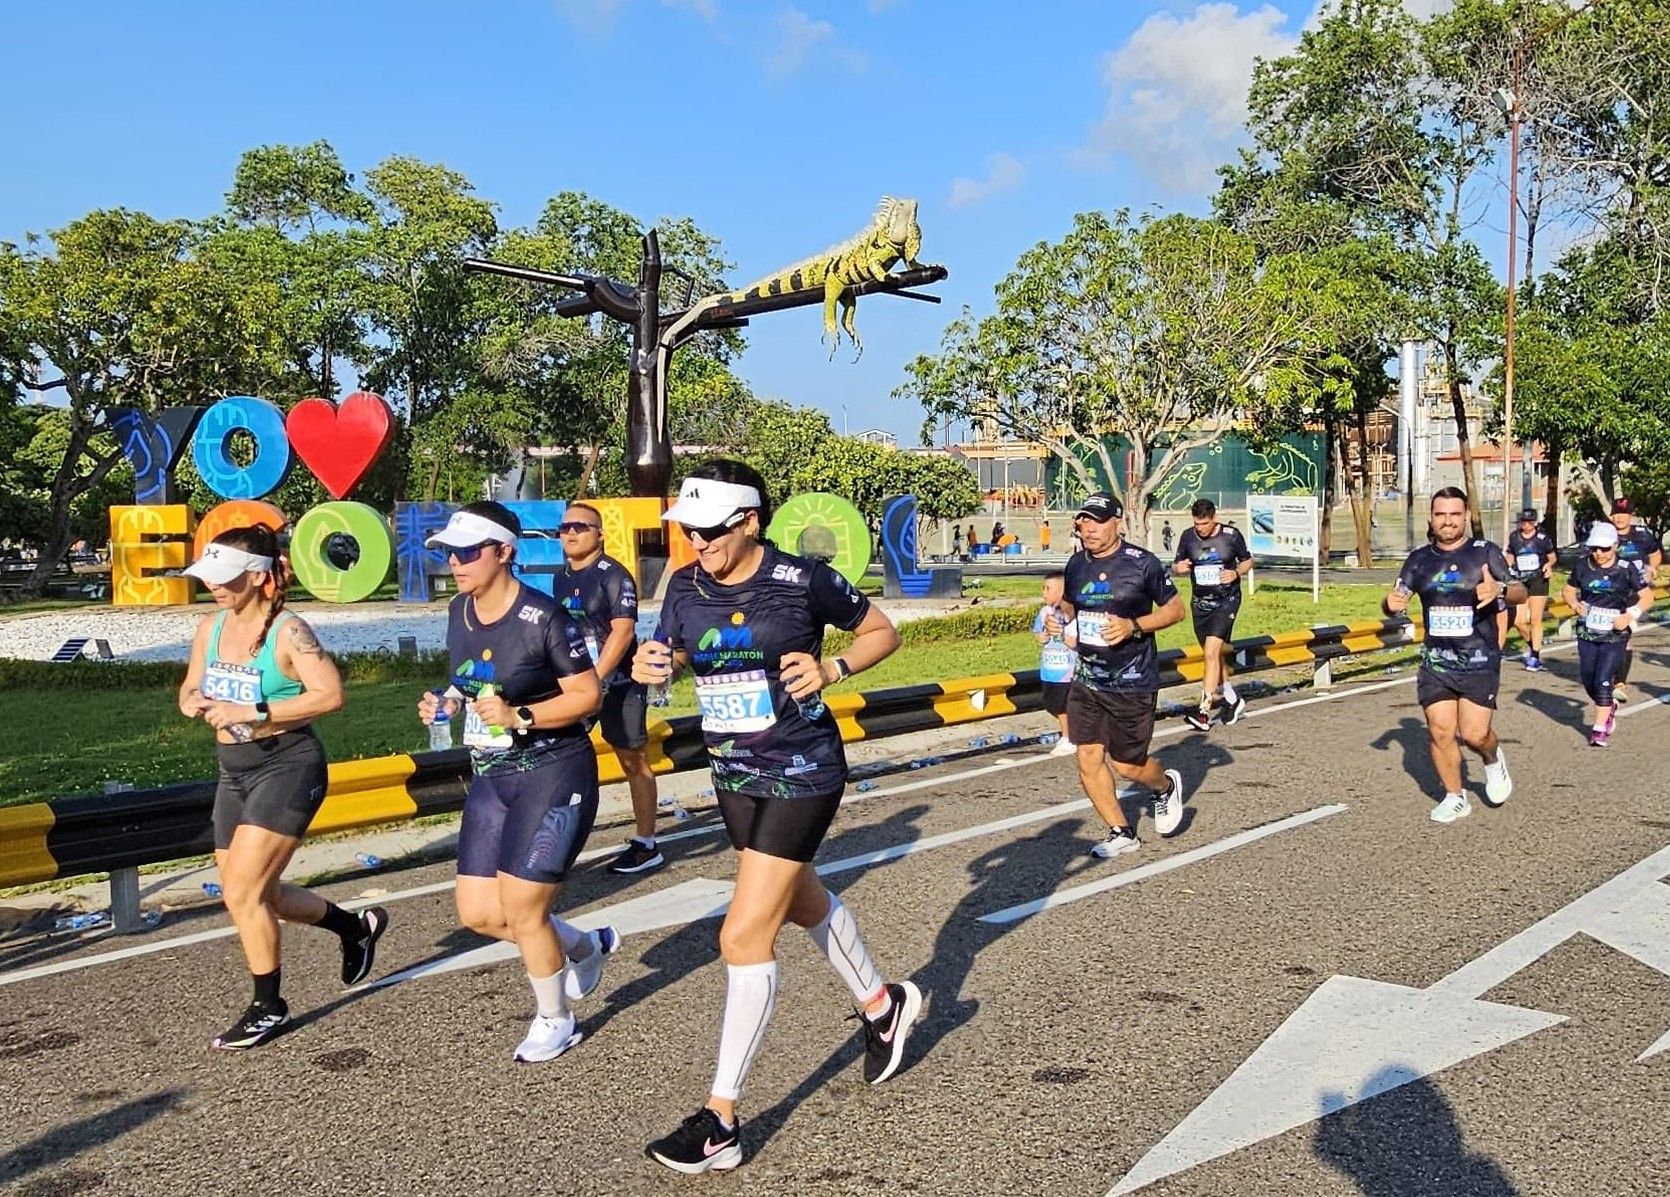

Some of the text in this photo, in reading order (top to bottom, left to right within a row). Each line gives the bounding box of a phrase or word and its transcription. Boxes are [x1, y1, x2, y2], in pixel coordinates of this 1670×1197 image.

[1431, 614, 1470, 630] 5520
[205, 675, 256, 701] 5416
[699, 692, 761, 720] 5587
